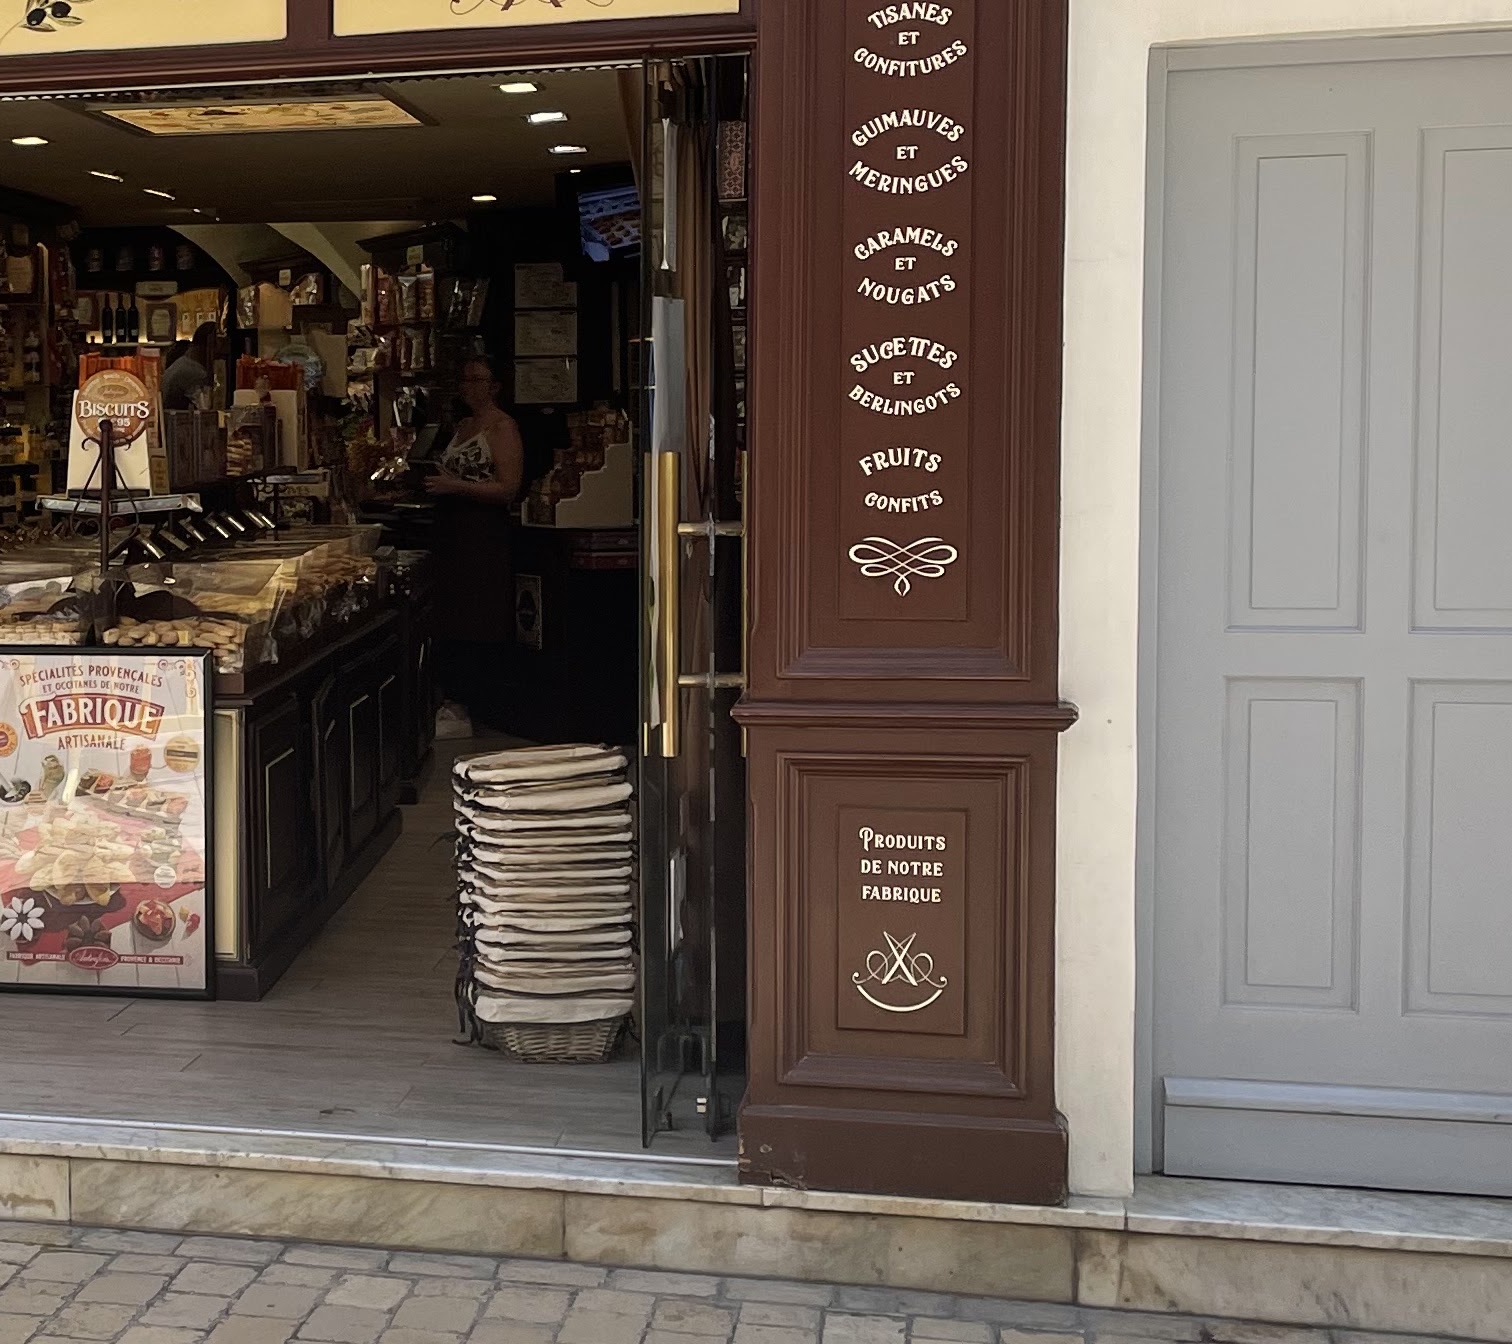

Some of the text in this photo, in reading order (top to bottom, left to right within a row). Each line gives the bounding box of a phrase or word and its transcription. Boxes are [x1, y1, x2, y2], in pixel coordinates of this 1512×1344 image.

[867, 1, 953, 29] TISANES
[898, 31, 921, 46] ET
[853, 39, 967, 77] CONFITURES
[851, 109, 965, 147] GUIMAUVES
[896, 145, 919, 160] ET
[848, 155, 968, 195] MERINGUES
[854, 226, 959, 260] CARAMELS
[894, 256, 917, 271] ET
[857, 274, 956, 305] NOUGATS
[850, 336, 958, 373] SUCETTES
[893, 371, 916, 385] ET
[78, 399, 150, 419] BISCUITS
[848, 382, 961, 416] BERLINGOTS
[858, 447, 942, 476] FRUITS
[864, 490, 943, 513] CONFITS
[19, 663, 163, 688] SPÉCIALITÉS PROVENÇALES
[42, 682, 53, 694] ET
[100, 679, 111, 690] DE
[18, 693, 159, 738] FABRIQUE
[57, 734, 126, 751] ARTISANALE
[859, 826, 946, 852] PRODUITS
[860, 859, 944, 877] DE NOTRE
[862, 885, 942, 904] FABRIQUE
